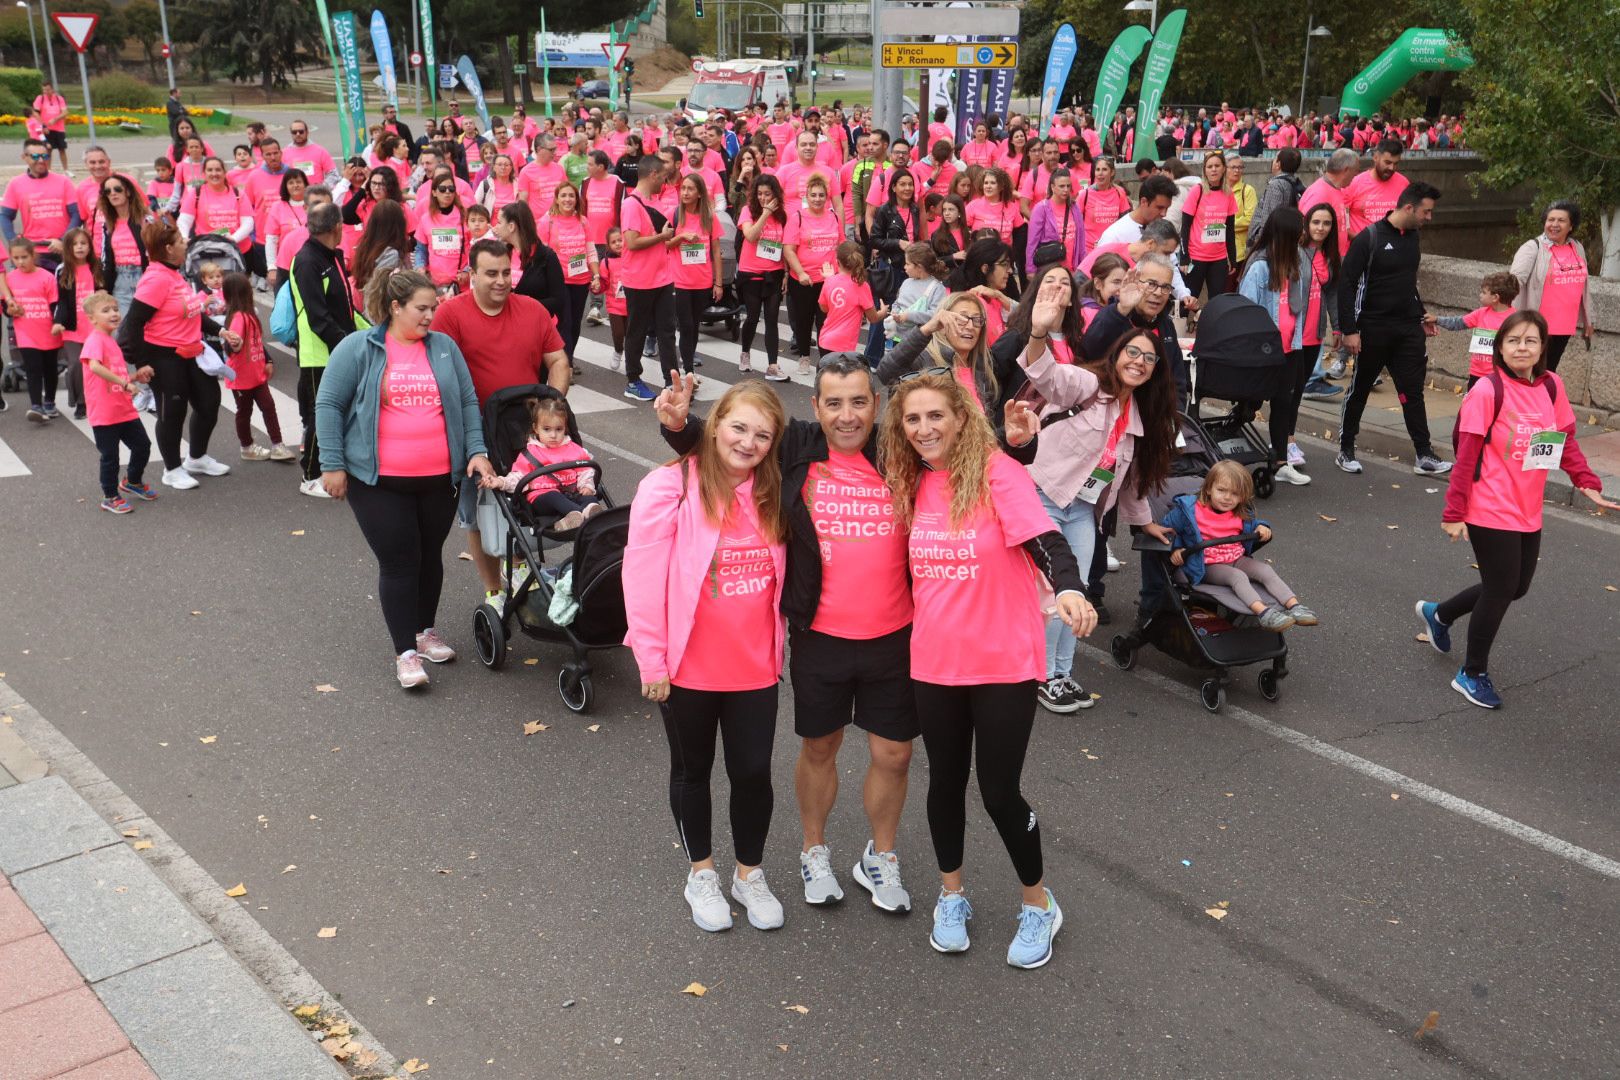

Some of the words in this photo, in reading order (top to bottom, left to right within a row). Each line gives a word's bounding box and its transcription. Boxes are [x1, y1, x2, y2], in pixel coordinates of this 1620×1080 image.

[897, 47, 924, 55] Vincci
[884, 56, 893, 64] H.
[896, 56, 906, 64] P.
[909, 56, 945, 64] Romano
[390, 371, 404, 381] En
[390, 383, 437, 393] contra
[1517, 424, 1531, 434] En
[816, 479, 837, 495] En
[814, 500, 880, 516] contra
[911, 526, 924, 540] En
[722, 549, 742, 562] En
[909, 544, 956, 560] contra
[957, 543, 977, 560] el
[719, 561, 774, 576] contra
[913, 559, 979, 581] cáncer
